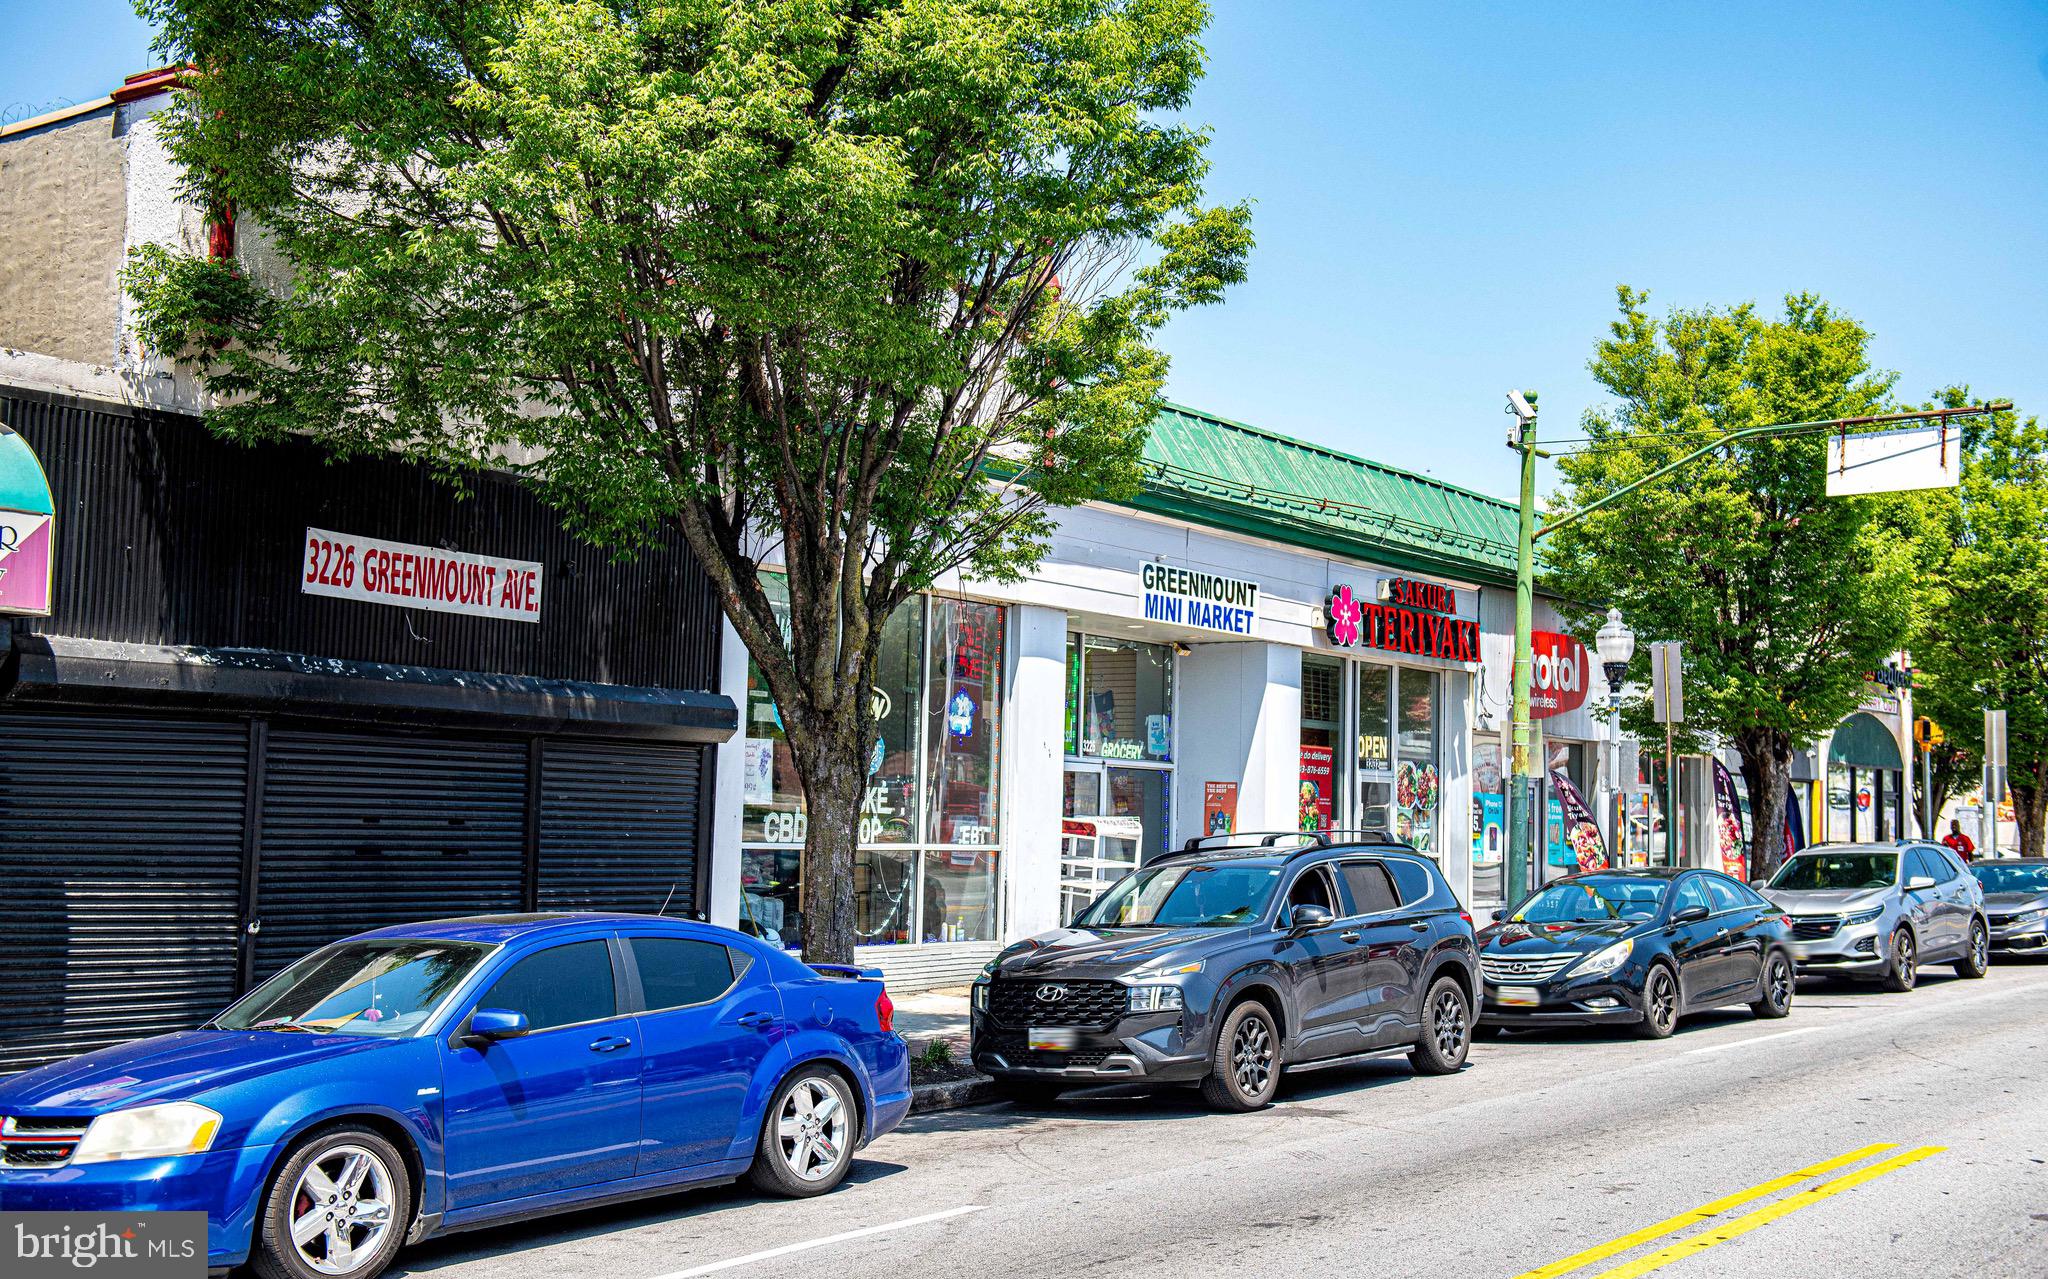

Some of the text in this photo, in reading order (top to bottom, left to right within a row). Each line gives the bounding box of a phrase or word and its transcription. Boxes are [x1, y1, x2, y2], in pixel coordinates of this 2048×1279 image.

[306, 538, 539, 612] 3226 GREENMOUNT AVE.
[1143, 563, 1257, 607] GREENMOUNT
[1394, 577, 1457, 615] SAKURA
[1145, 593, 1254, 634] MINI MARKET
[1362, 602, 1482, 663] TERIYAKI
[1101, 742, 1143, 759] GROCERY
[1304, 751, 1311, 760] do
[1311, 752, 1331, 763] delivery
[1358, 736, 1388, 759] OPEN
[1299, 765, 1330, 775] 3-876-6559
[860, 785, 891, 815] KE
[763, 812, 807, 842] CBD
[856, 815, 882, 843] OP
[959, 826, 991, 844] EBT
